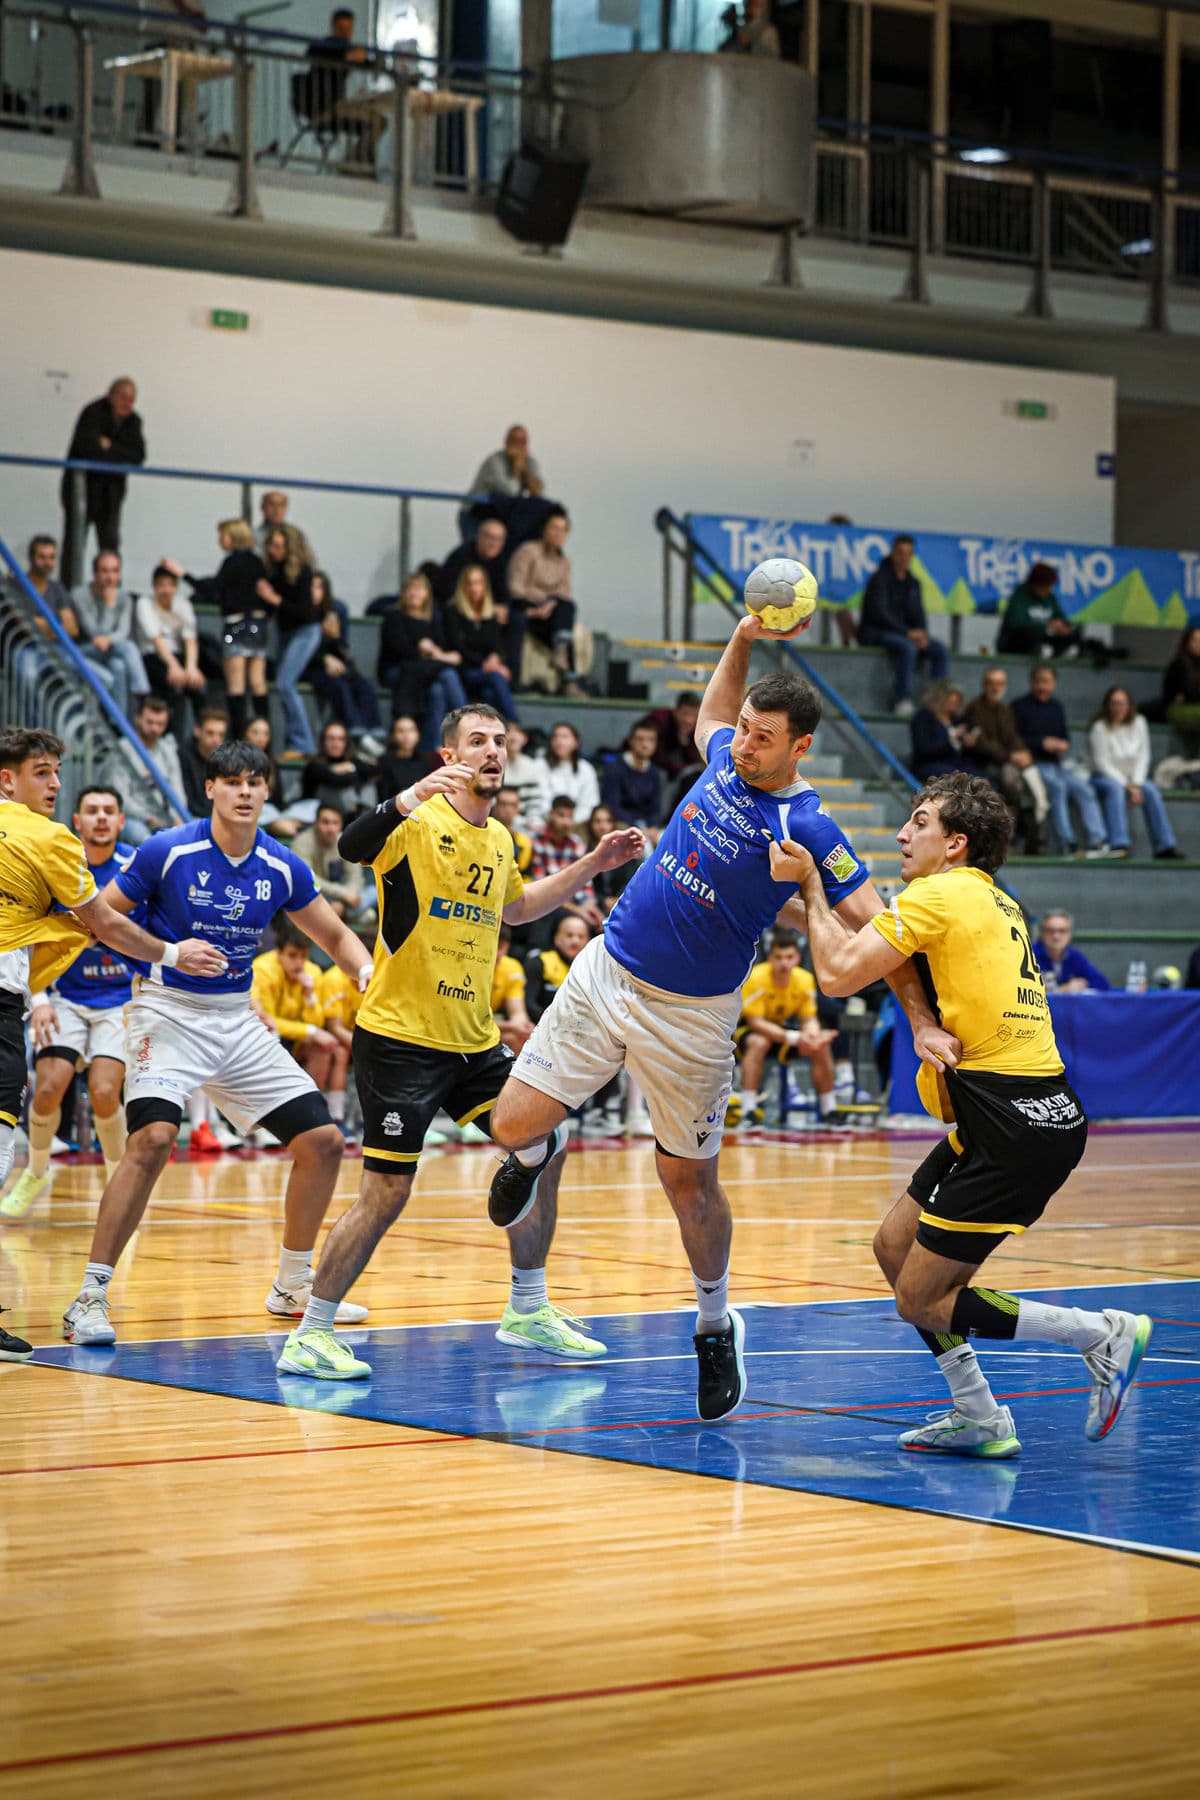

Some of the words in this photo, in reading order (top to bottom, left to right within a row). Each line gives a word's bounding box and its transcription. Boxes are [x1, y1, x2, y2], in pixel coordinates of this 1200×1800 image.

[720, 520, 891, 585] TRNTINO
[959, 539, 1116, 598] TREINO
[254, 879, 272, 901] 18
[466, 863, 494, 897] 27
[660, 850, 678, 872] ME
[675, 866, 716, 903] GUSTA
[453, 901, 482, 922] BTS
[437, 980, 476, 1003] firmin
